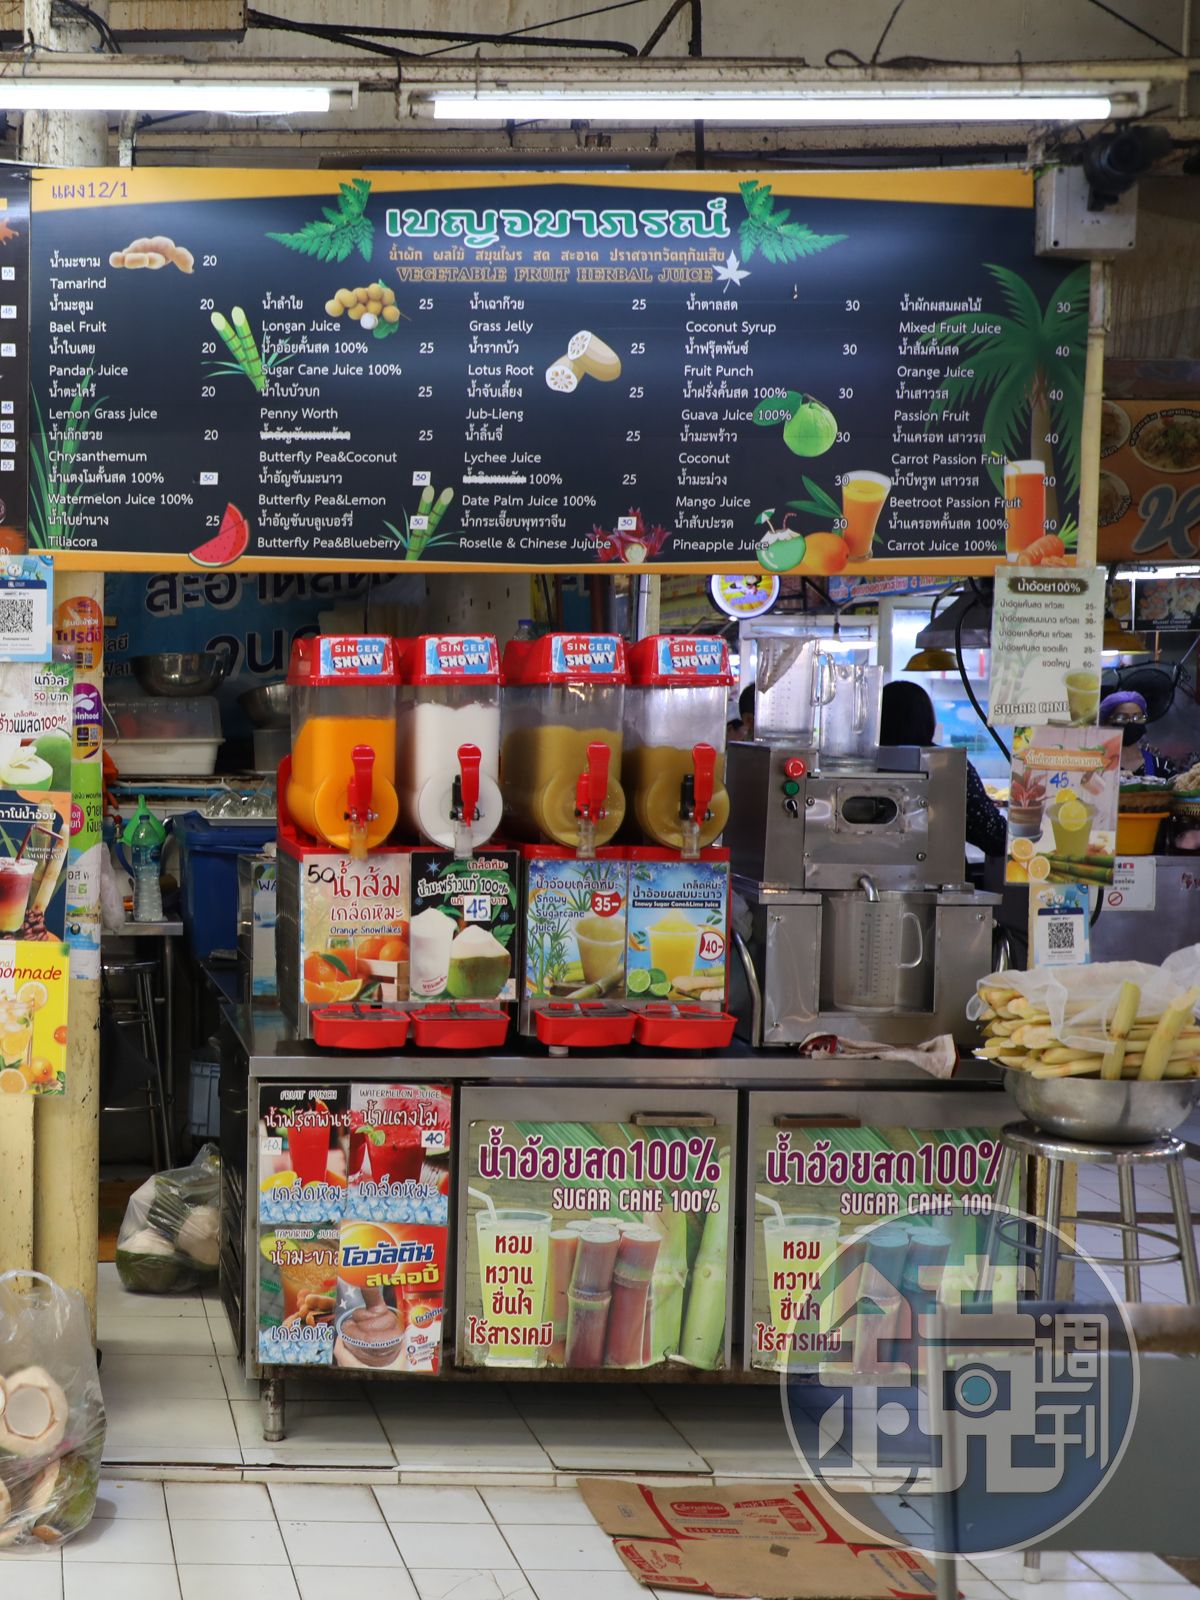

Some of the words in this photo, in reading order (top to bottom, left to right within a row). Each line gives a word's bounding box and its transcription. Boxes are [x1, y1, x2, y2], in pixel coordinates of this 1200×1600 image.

[51, 181, 128, 199] แผง12/1
[49, 250, 101, 268] น้ำมะขาม
[202, 255, 217, 267] 20
[433, 246, 465, 261] ผลไม้
[533, 249, 550, 261] สด
[560, 249, 599, 261] สะอาด
[49, 276, 107, 288] Tamarind
[397, 266, 507, 283] VEGETABLE
[514, 266, 570, 283] FRUIT
[576, 266, 653, 283] HERBAL
[658, 266, 712, 283] JUICE
[262, 319, 306, 334] Longan
[309, 319, 341, 331] Juice
[684, 364, 713, 376] Fruit
[715, 364, 754, 376] Punch
[49, 407, 91, 419] Lemon
[94, 407, 126, 419] Grass
[260, 407, 299, 422] Penny
[301, 407, 338, 419] Worth
[465, 407, 524, 422] Jub-Lieng
[48, 450, 148, 465] Chrysanthemum
[259, 450, 312, 465] Butterfly
[315, 450, 398, 462] Pea&Coconut
[678, 452, 731, 464] Coconut
[48, 493, 122, 505] Watermelon
[125, 493, 156, 505] Juice
[160, 493, 194, 505] 100%
[48, 535, 98, 547] Tiliacora
[672, 539, 734, 554] Pineapple
[737, 539, 769, 551] Juice
[887, 539, 925, 551] Carrot
[928, 539, 960, 551] Juice
[964, 539, 998, 551] 100%
[334, 644, 380, 653] SINGER
[440, 644, 486, 653] SINGER
[566, 642, 612, 651] SINGER
[673, 644, 718, 653] SINGER
[332, 653, 384, 668] SNOWY
[438, 653, 490, 668] SNOWY
[564, 651, 616, 667] SNOWY
[671, 653, 722, 668] SNOWY
[33, 692, 46, 701] 50
[50, 691, 69, 702] บาท
[994, 703, 1036, 715] SUGAR
[307, 863, 336, 884] 50
[332, 860, 401, 899] น้ำส้ม
[480, 879, 509, 894] 100%
[536, 894, 568, 905] Snowy
[634, 901, 652, 909] Snowy
[653, 901, 670, 909] Sugar
[330, 904, 405, 922] เกล็ดหิมะ
[535, 909, 585, 920] Sugarcane
[330, 926, 359, 936] Orange
[360, 925, 402, 935] Snowflakes
[534, 923, 558, 933] Juice
[280, 1090, 306, 1100] FRUIT
[308, 1090, 338, 1100] PUNCH
[360, 1089, 413, 1099] WATERMELON
[417, 1090, 441, 1099] JUICE
[360, 1101, 439, 1127] น้ำแตงโม
[272, 1177, 349, 1202] เกล็ดหิมะ
[359, 1173, 440, 1199] เกล็ดหิมะ
[552, 1188, 612, 1212] SUGAR
[619, 1188, 663, 1212] CANE
[671, 1188, 720, 1213] 100%
[840, 1192, 900, 1215] SUGAR
[908, 1193, 953, 1216] CANE
[961, 1194, 994, 1216] 100
[275, 1229, 315, 1240] TAMARIND
[494, 1234, 534, 1255] หอม
[782, 1240, 821, 1261] หอม
[341, 1239, 435, 1267] โอวัลติน
[485, 1264, 534, 1285] หวาน
[773, 1270, 822, 1291] หวาน
[491, 1284, 533, 1316] ชื่นใจ
[779, 1292, 821, 1322] ชื่นใจ
[467, 1316, 553, 1347] ไร้สารเคมี
